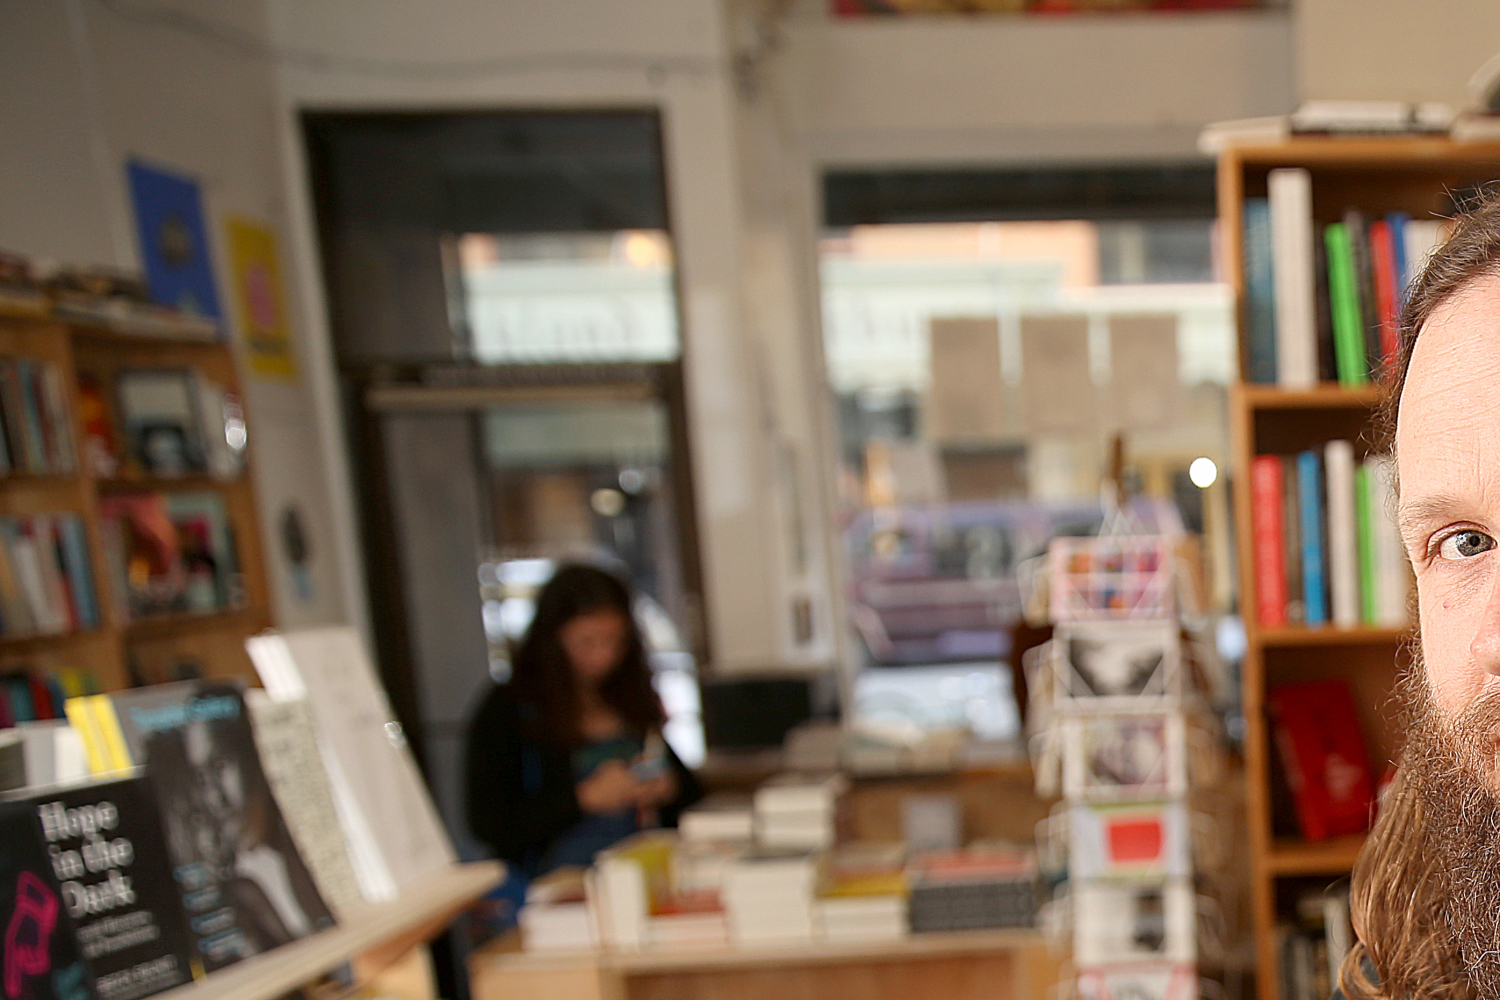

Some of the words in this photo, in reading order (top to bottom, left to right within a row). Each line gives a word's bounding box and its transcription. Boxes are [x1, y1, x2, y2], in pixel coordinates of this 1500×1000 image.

[38, 800, 120, 846] Hope
[48, 844, 86, 880] in
[82, 832, 135, 874] the
[60, 868, 137, 919] Dark
